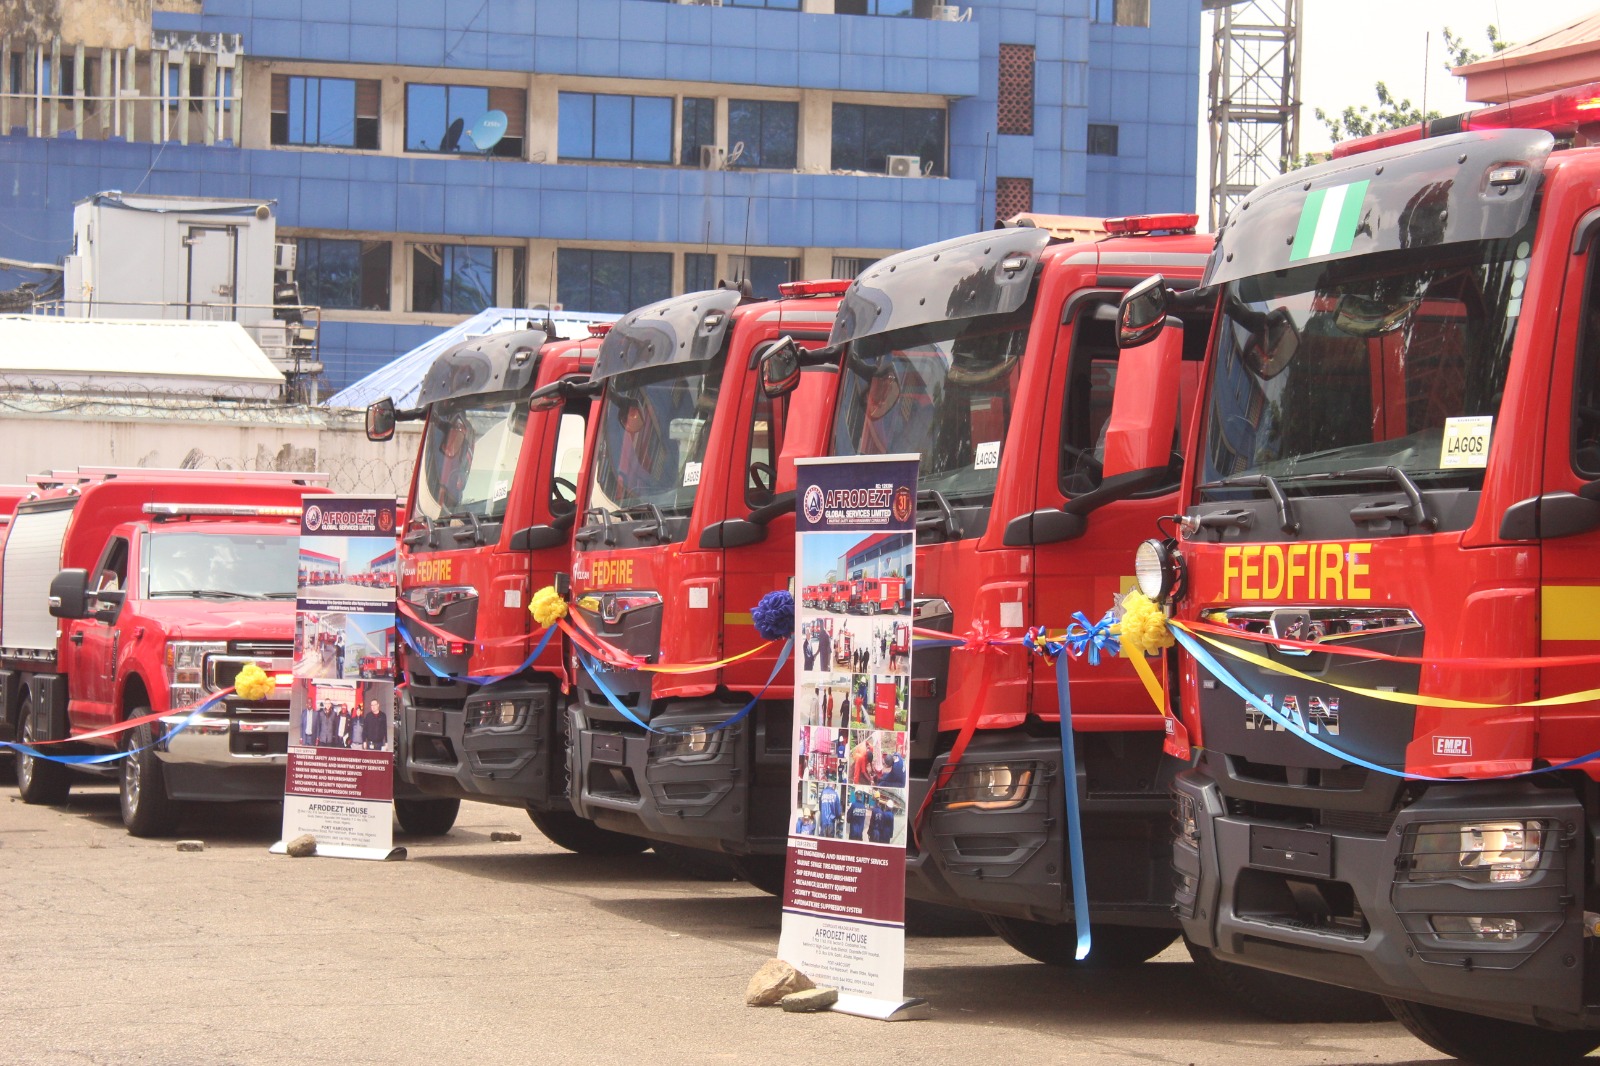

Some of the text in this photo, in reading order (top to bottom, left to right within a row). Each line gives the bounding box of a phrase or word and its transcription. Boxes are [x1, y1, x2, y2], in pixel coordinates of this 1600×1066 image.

[1448, 436, 1482, 453] LAGOS
[976, 451, 996, 465] LAGOS
[825, 489, 893, 508] AFRODEZT
[322, 511, 377, 525] AFRODEZT
[825, 509, 891, 518] GLOBAL SERVICES LIMITED
[417, 559, 452, 582] FEDFIRE
[592, 559, 633, 585] FEDFIRE
[1224, 543, 1372, 600] FEDFIRE
[1246, 694, 1339, 736] MAN
[1437, 738, 1467, 754] EMPL
[309, 803, 344, 812] AFRODEZT
[346, 806, 368, 814] HOUSE
[846, 864, 862, 873] SYSTEM
[870, 857, 889, 866] SERVICES
[815, 928, 845, 941] AFRODEZT
[846, 932, 868, 944] HOUSE
